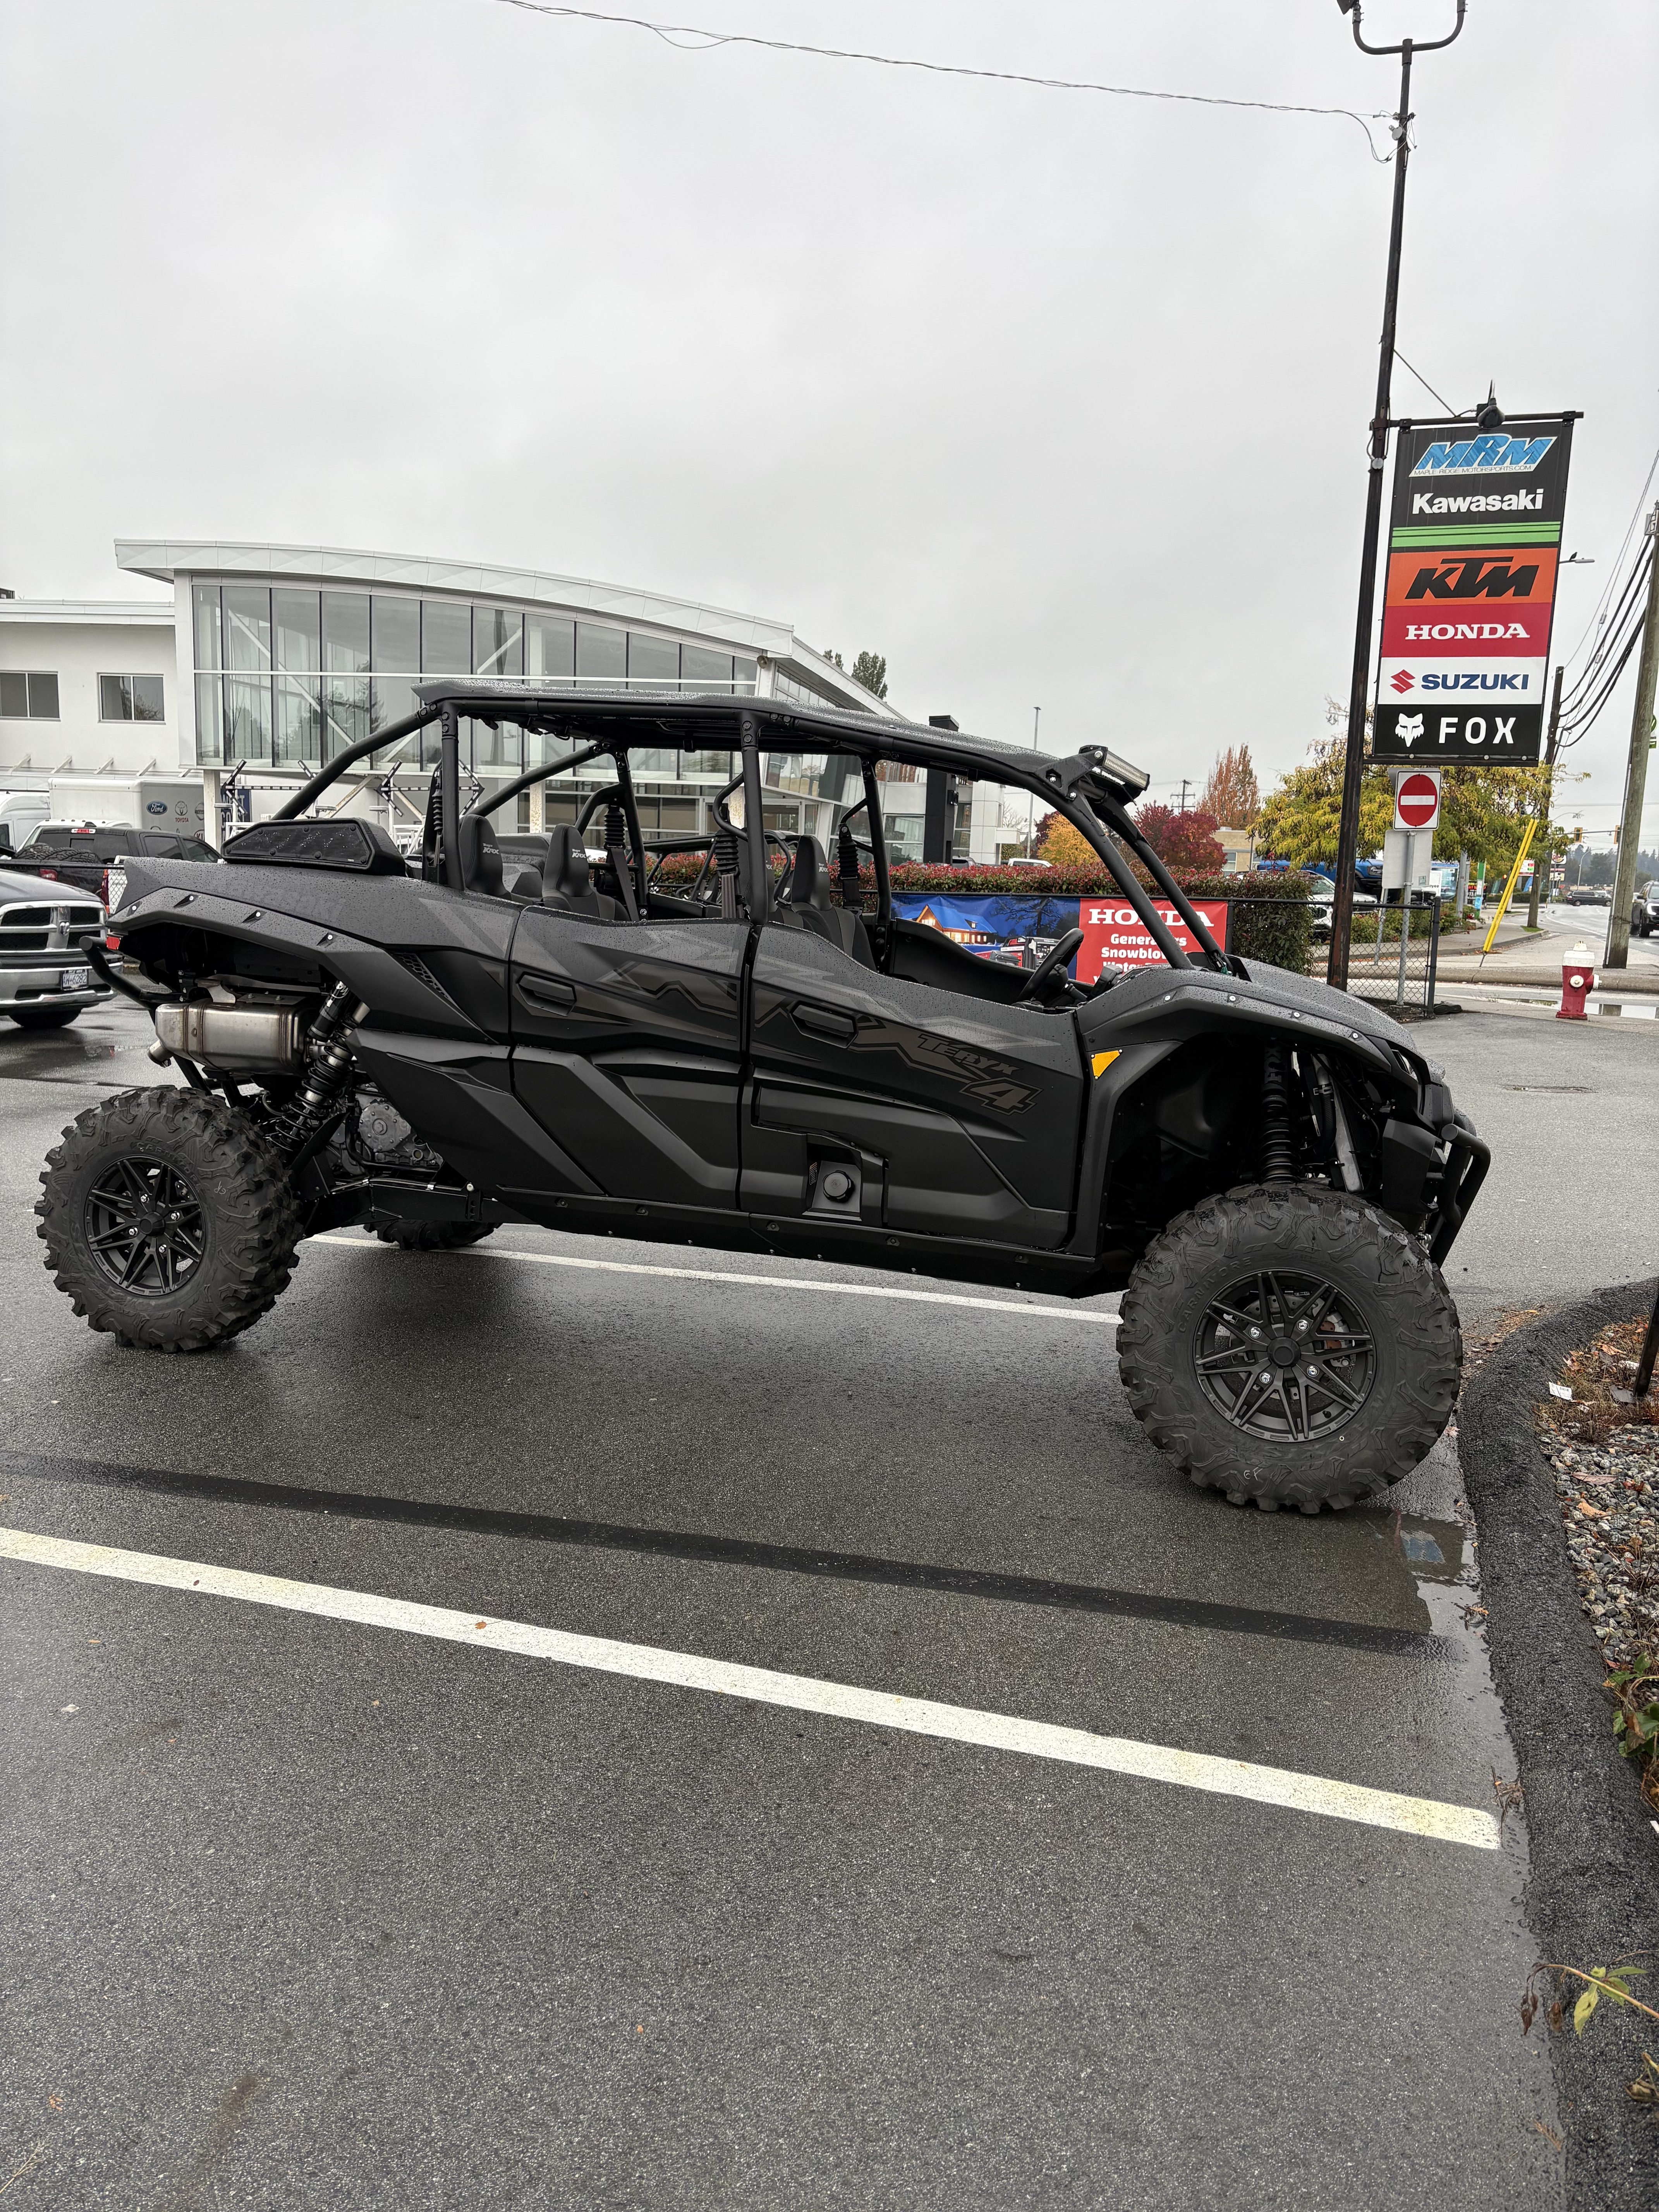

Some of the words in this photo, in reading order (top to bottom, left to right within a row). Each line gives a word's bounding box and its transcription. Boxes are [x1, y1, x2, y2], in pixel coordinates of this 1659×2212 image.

[1413, 434, 1555, 470] MRM
[1412, 489, 1544, 514] Kawasaki
[1405, 556, 1540, 599] KTM
[1405, 623, 1530, 640] HONDA
[1421, 674, 1529, 690] SUZUKI
[1439, 717, 1516, 744] FOX
[151, 803, 164, 813] Ford
[917, 1033, 1022, 1075] TERYX
[966, 1080, 1036, 1111] 4
